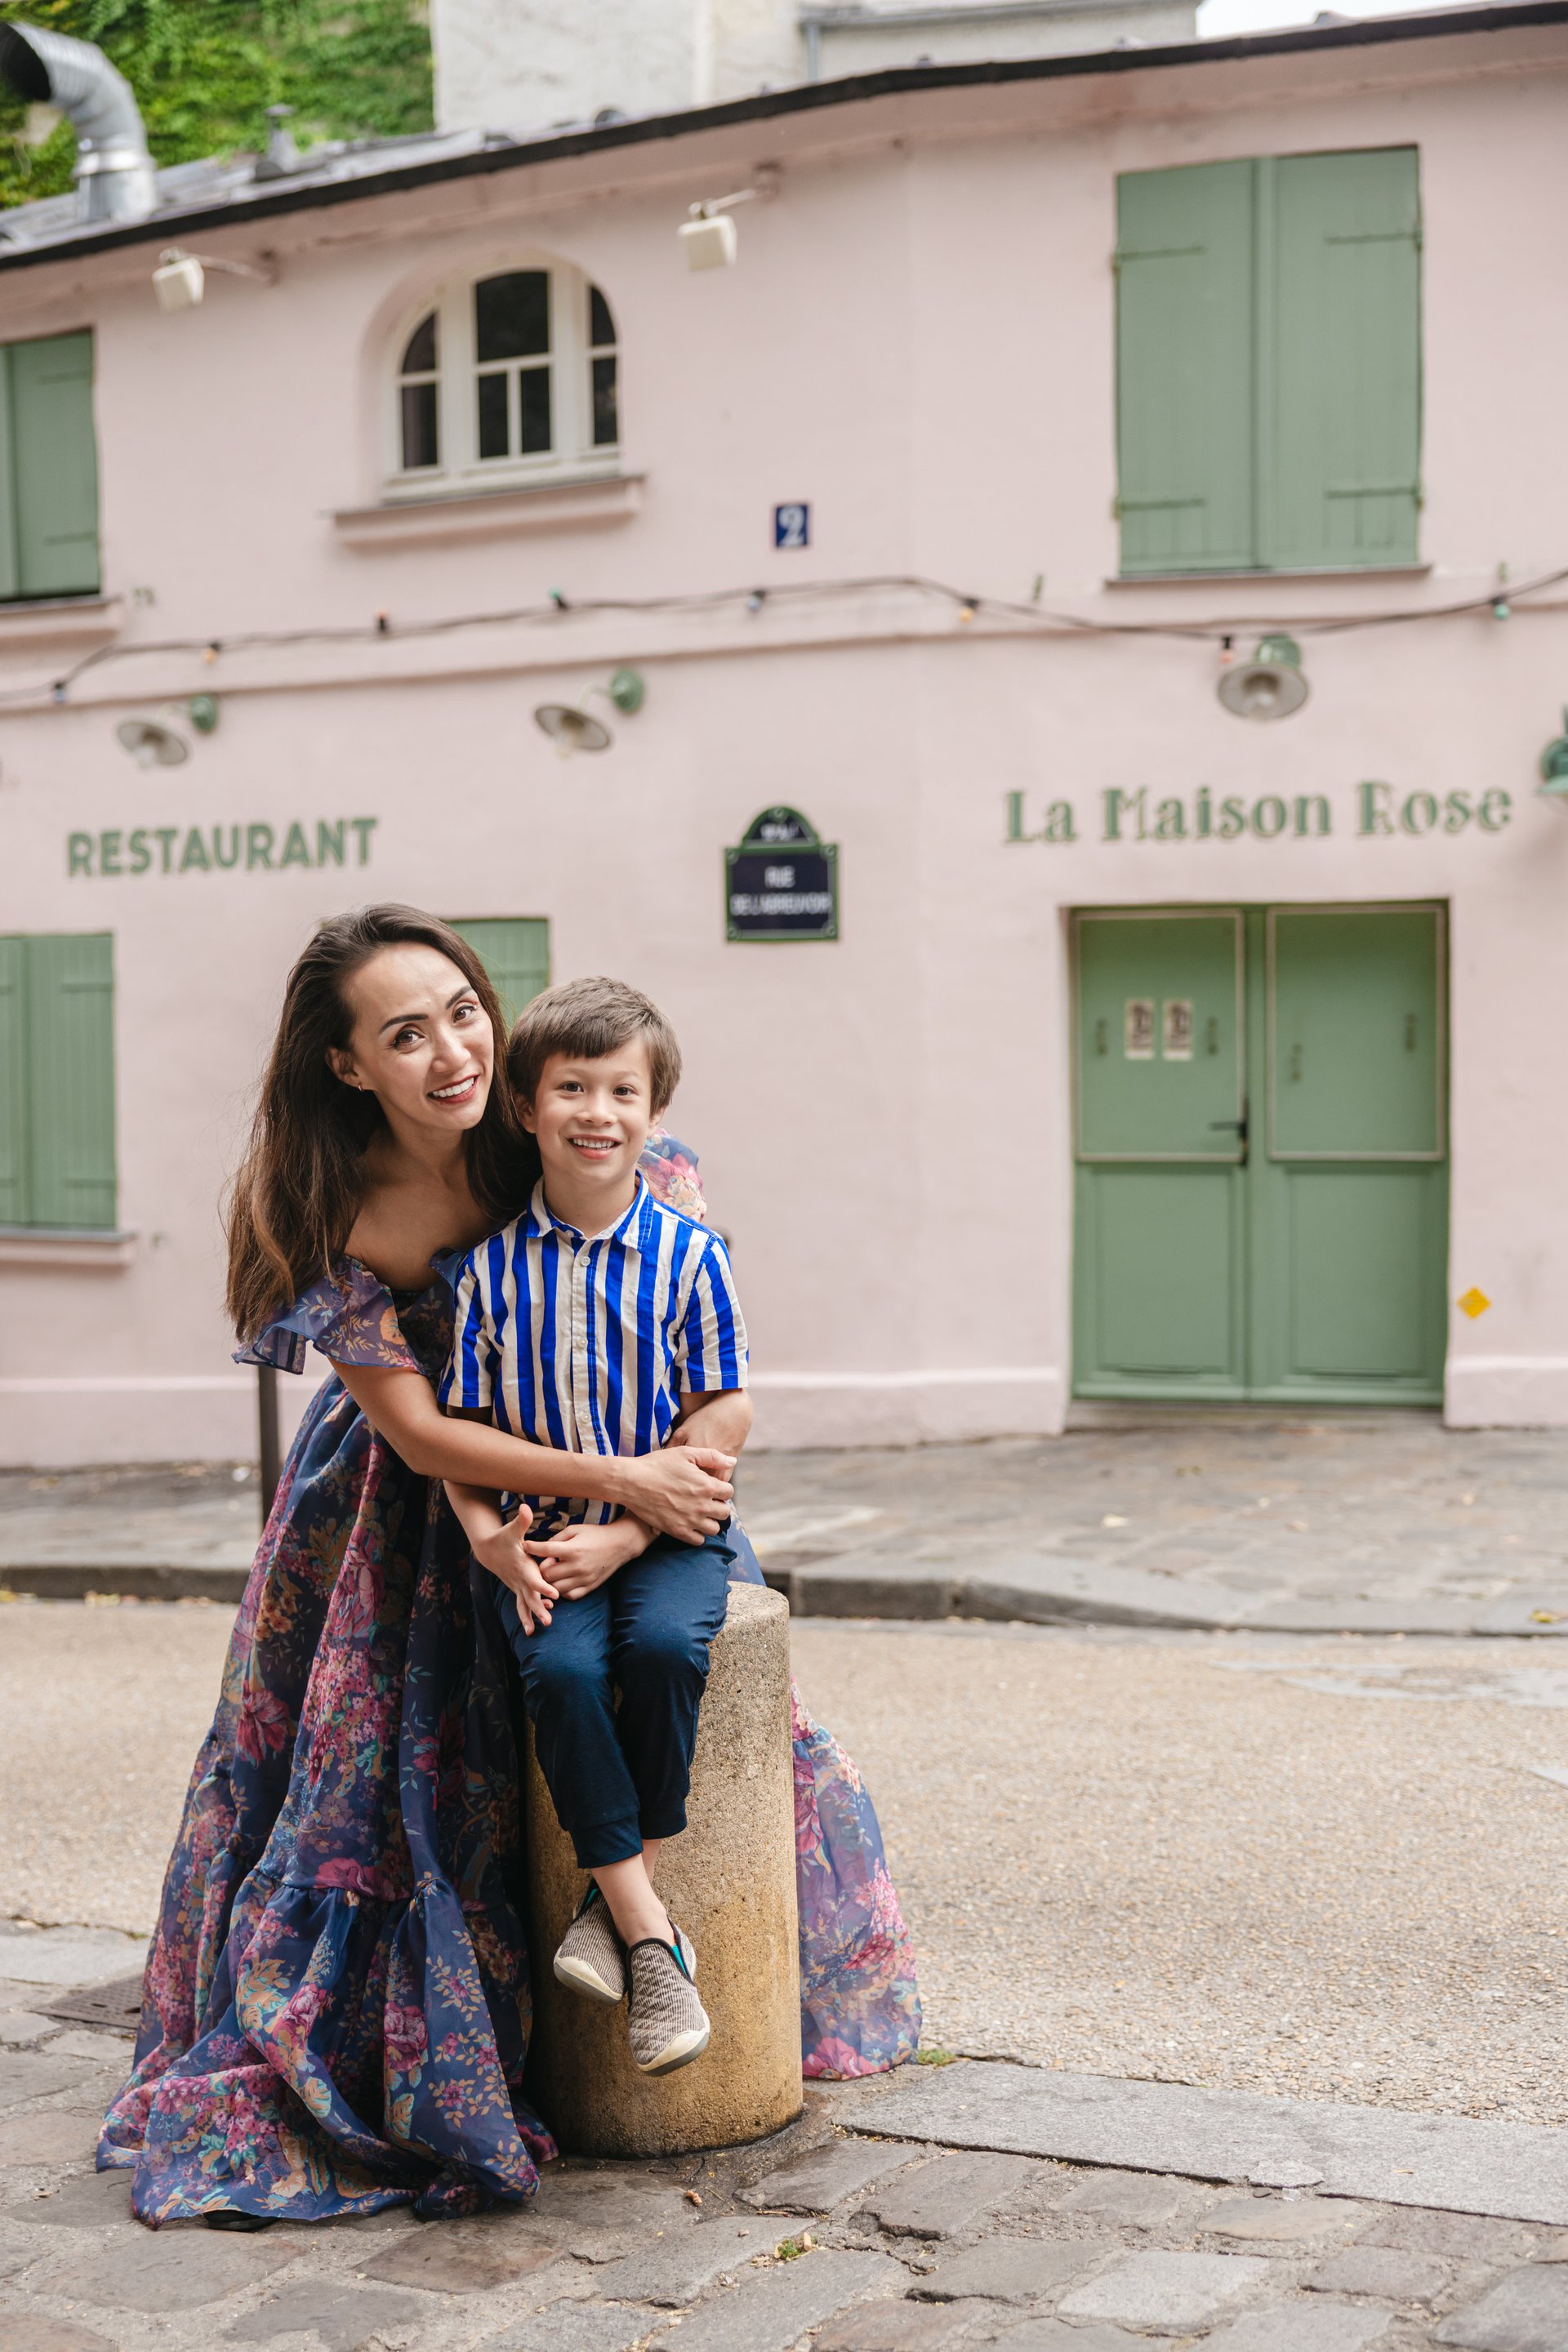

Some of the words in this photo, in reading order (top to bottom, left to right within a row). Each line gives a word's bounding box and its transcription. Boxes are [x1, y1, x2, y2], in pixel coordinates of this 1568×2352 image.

[777, 504, 805, 549] 2
[1004, 789, 1076, 843] La
[1100, 785, 1332, 841] Maison
[1356, 780, 1512, 837] Rose
[68, 817, 376, 877] RESTAURANT
[764, 866, 795, 888] RUE
